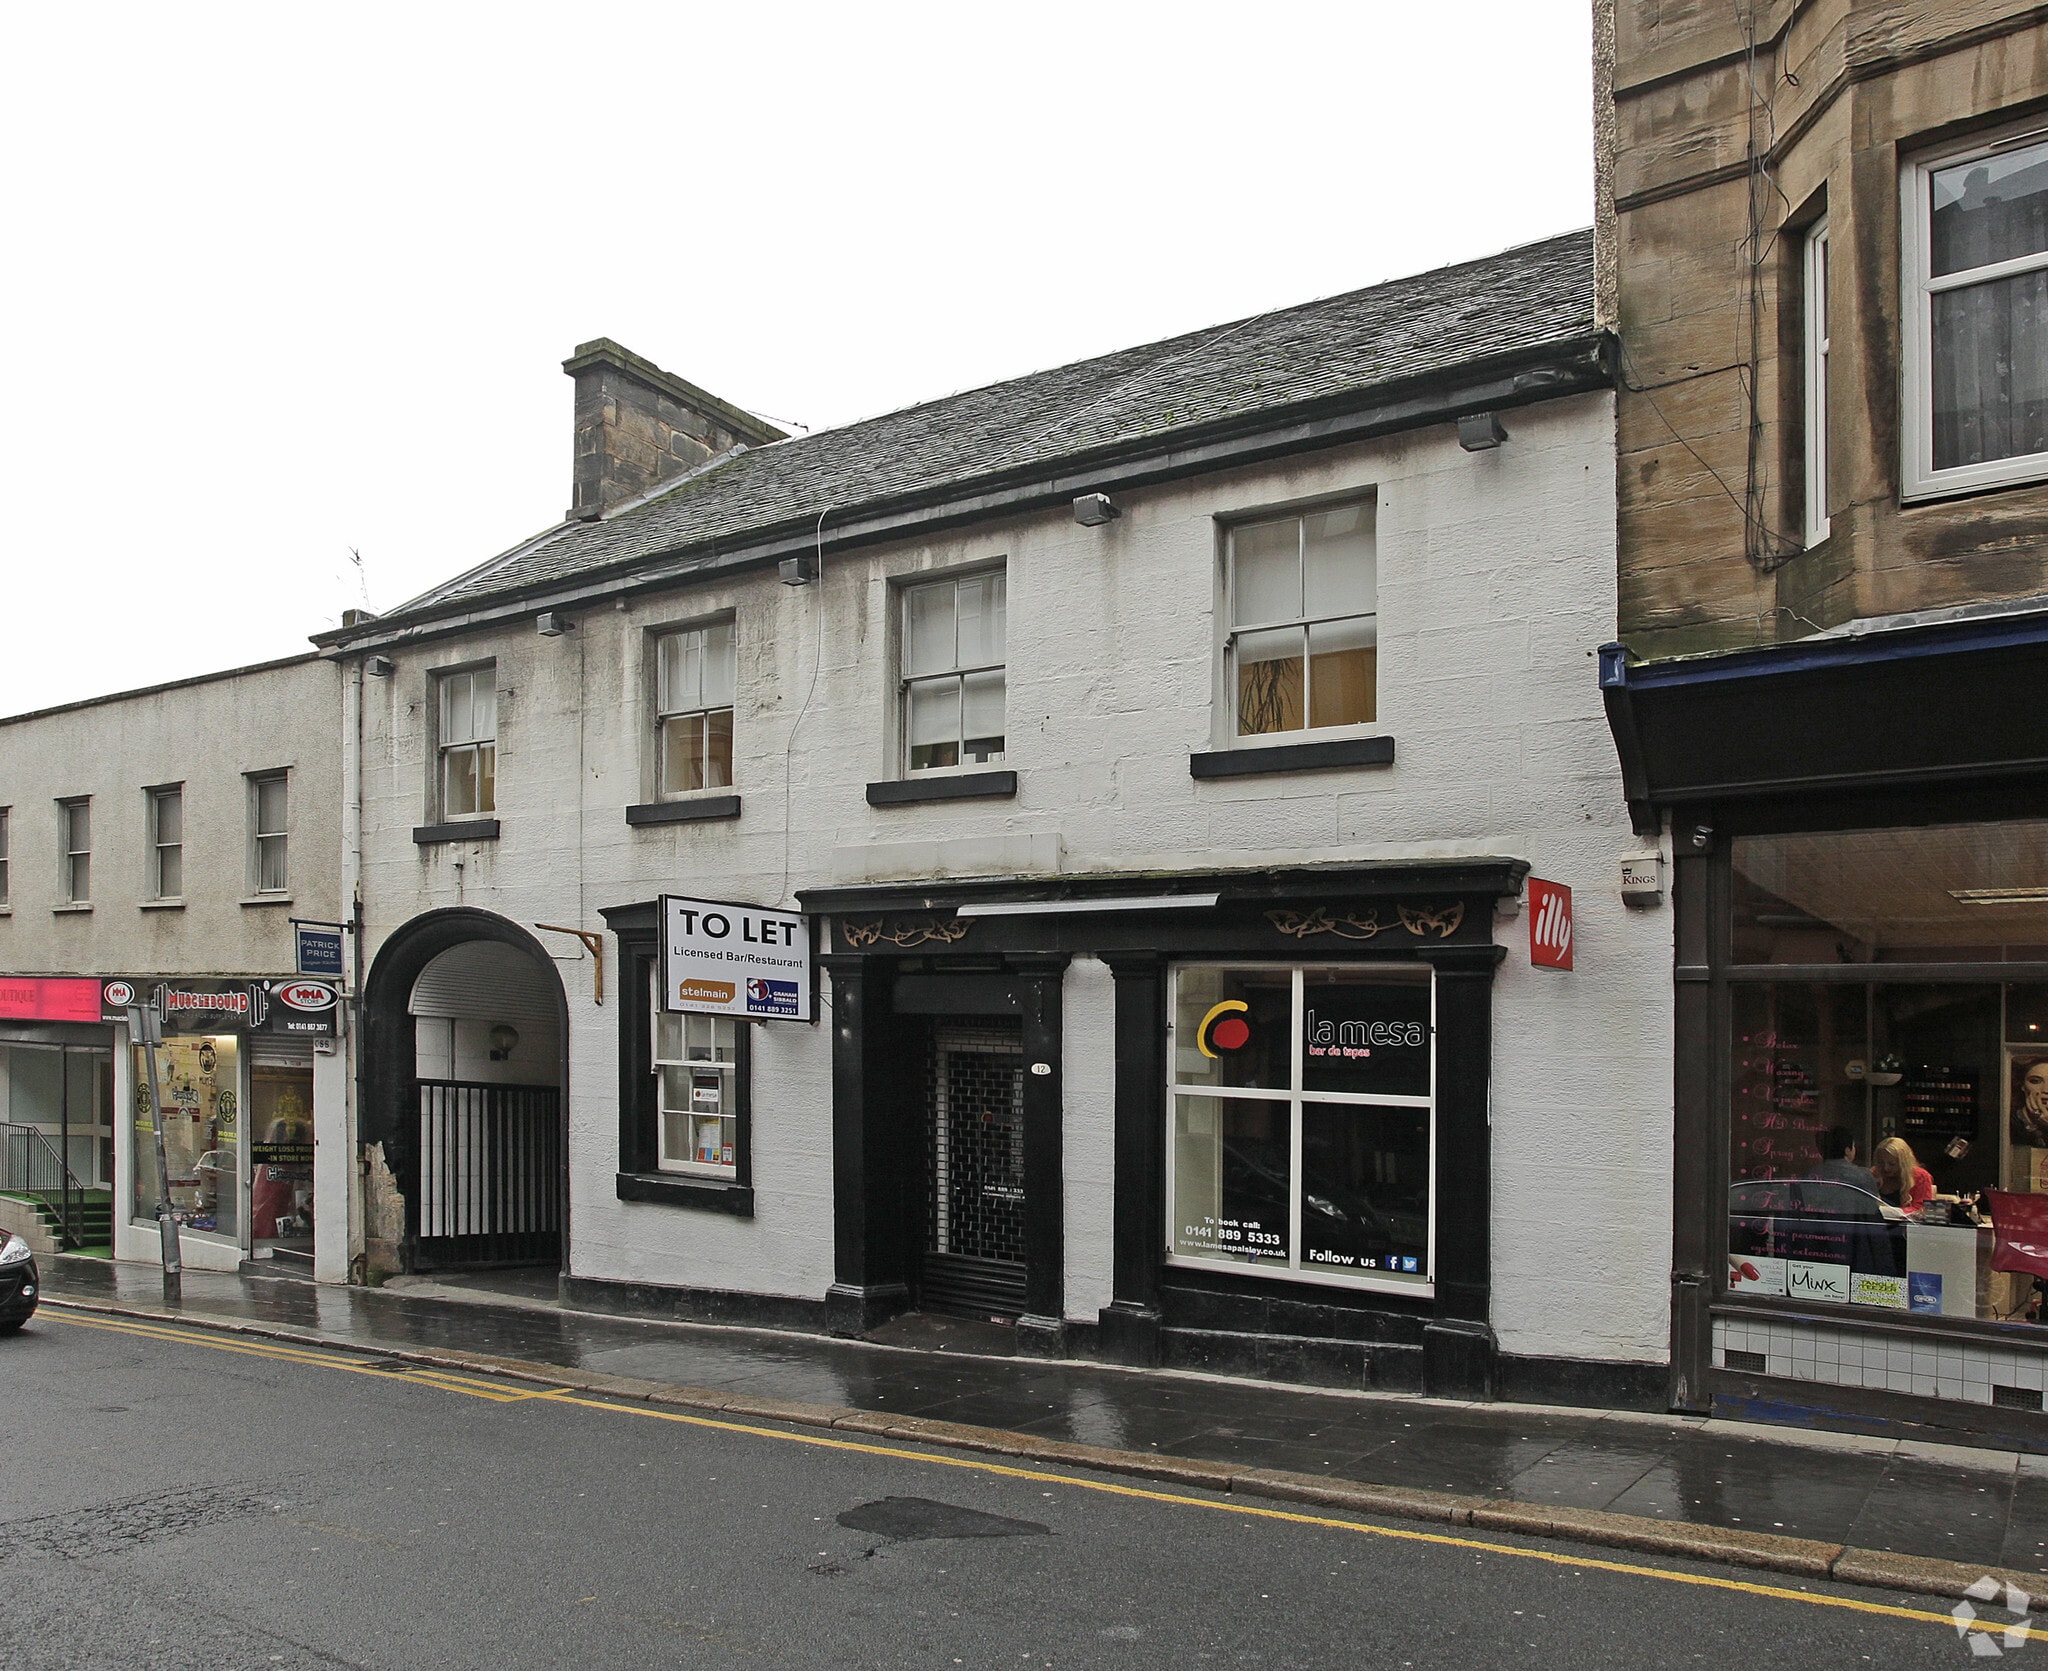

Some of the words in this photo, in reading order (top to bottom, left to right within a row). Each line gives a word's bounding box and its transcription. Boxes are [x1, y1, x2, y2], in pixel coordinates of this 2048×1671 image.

[1622, 875, 1656, 885] KINGS
[679, 908, 731, 939] TO
[743, 916, 798, 947] LET
[1535, 893, 1572, 961] illy
[301, 940, 340, 950] PATRICK
[306, 949, 336, 959] PRICE
[673, 945, 723, 960] Licensed
[726, 951, 803, 968] Bar/Restaurant
[112, 988, 127, 997] MMA
[295, 989, 325, 999] MMA
[681, 986, 728, 999] stelmain
[772, 996, 798, 1004] SIBBALD
[749, 1004, 766, 1012] 0141
[767, 1006, 780, 1014] 889
[781, 1007, 797, 1015] 3251
[1339, 1020, 1425, 1047] mesa
[1308, 1044, 1326, 1056] bar
[1328, 1045, 1341, 1056] de
[1343, 1046, 1371, 1060] tapas
[1036, 1065, 1046, 1074] 12
[253, 1145, 277, 1153] WEIGHT
[278, 1145, 295, 1153] LOSS
[1203, 1216, 1215, 1225] To
[1218, 1217, 1239, 1227] book
[1242, 1219, 1261, 1229] call:
[1185, 1225, 1212, 1238] 0141
[1218, 1228, 1242, 1241] 889
[1247, 1231, 1281, 1245] 5333
[1179, 1238, 1287, 1258] www.lamesapaisley.co.uk
[1309, 1249, 1355, 1265] Follow
[1360, 1257, 1377, 1268] us
